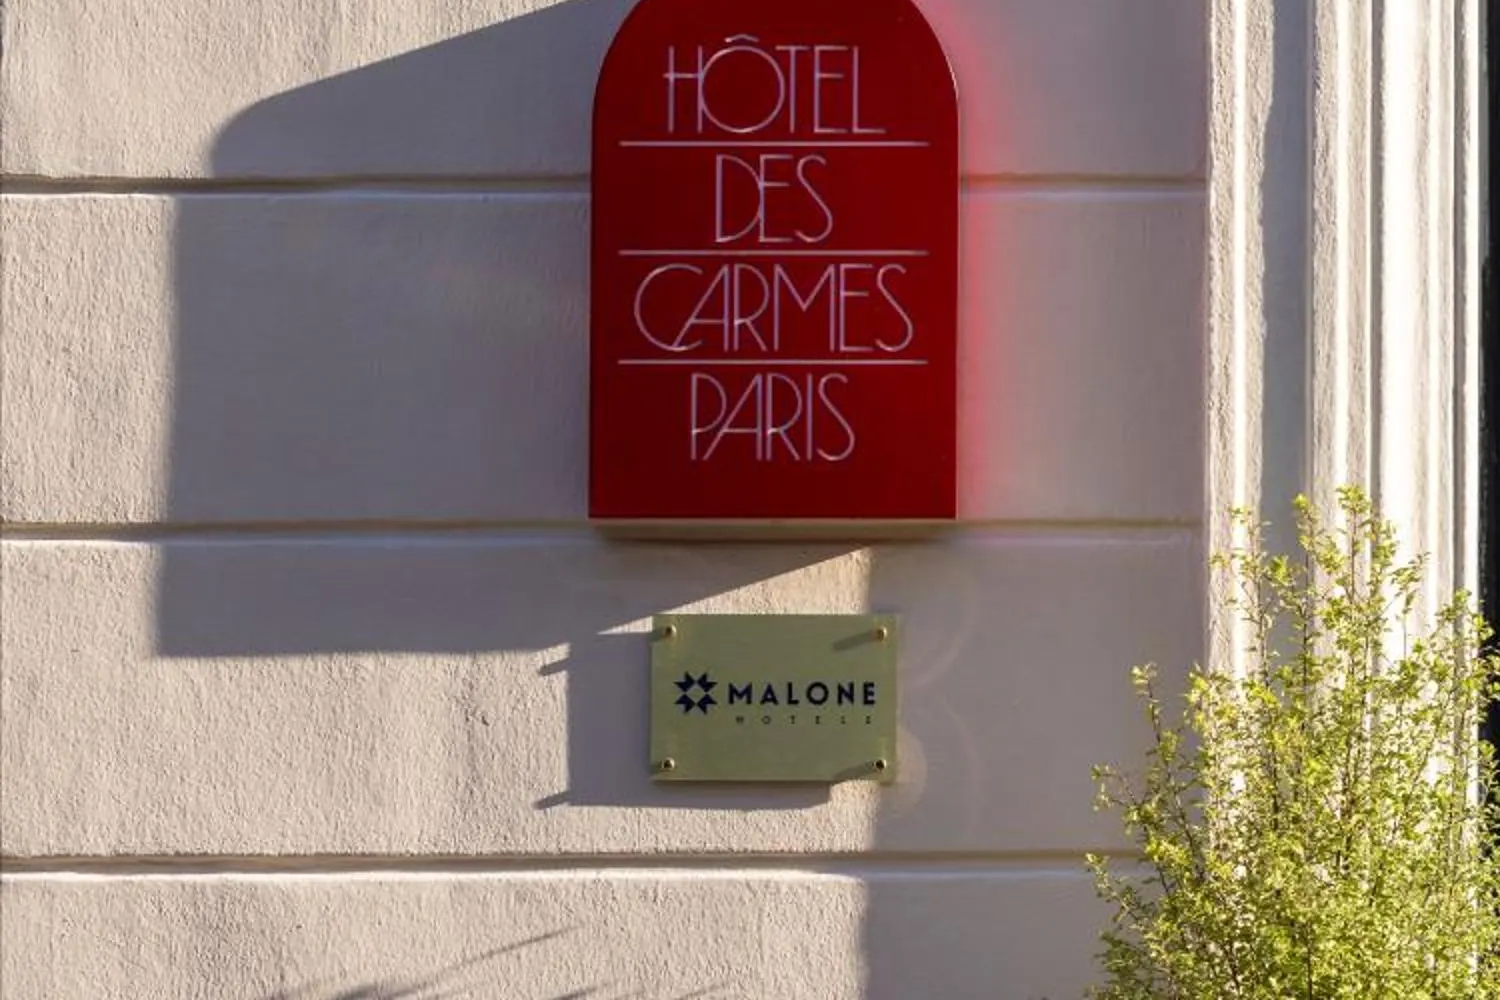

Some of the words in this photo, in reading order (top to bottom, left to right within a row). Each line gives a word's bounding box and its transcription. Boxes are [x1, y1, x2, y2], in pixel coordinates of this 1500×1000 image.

[663, 33, 887, 133] HÔTEL
[715, 153, 834, 243] DES
[633, 263, 914, 352] CARMES
[690, 373, 856, 461] PARIS
[727, 681, 877, 706] MALONE
